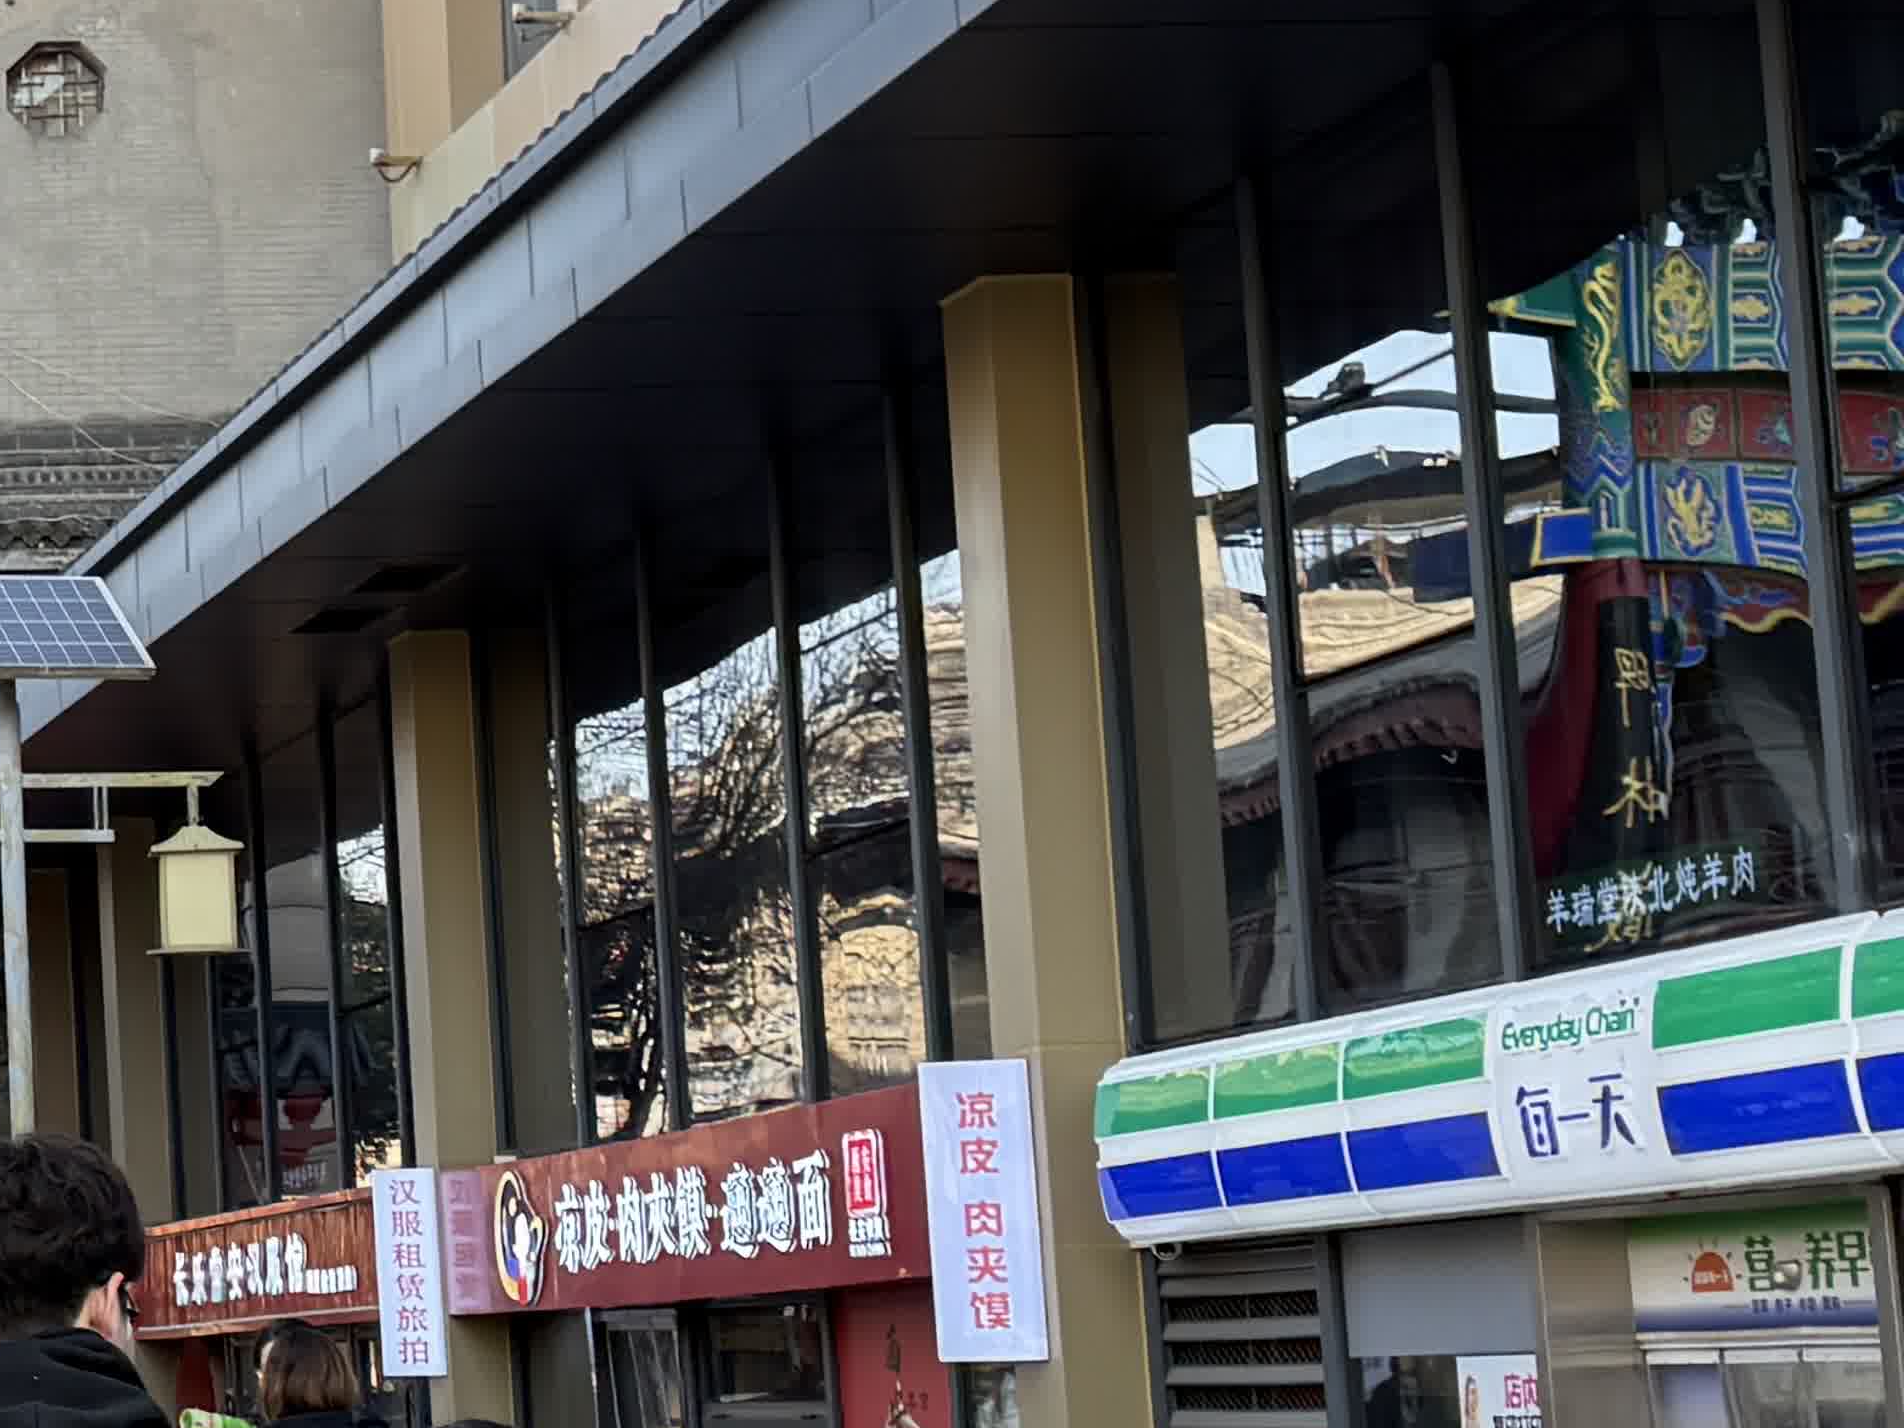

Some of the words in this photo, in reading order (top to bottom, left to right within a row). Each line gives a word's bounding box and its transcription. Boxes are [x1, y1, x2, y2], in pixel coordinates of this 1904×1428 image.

[1501, 1014, 1583, 1051] Everyday
[1585, 1005, 1636, 1042] Chain
[954, 1090, 1001, 1177] 凉皮
[1515, 1073, 1636, 1159] 每一天
[390, 1179, 430, 1365] 汉服租赁旅拍
[961, 1200, 1014, 1333] 肉夹馍
[1744, 1230, 1872, 1292] 营养早
